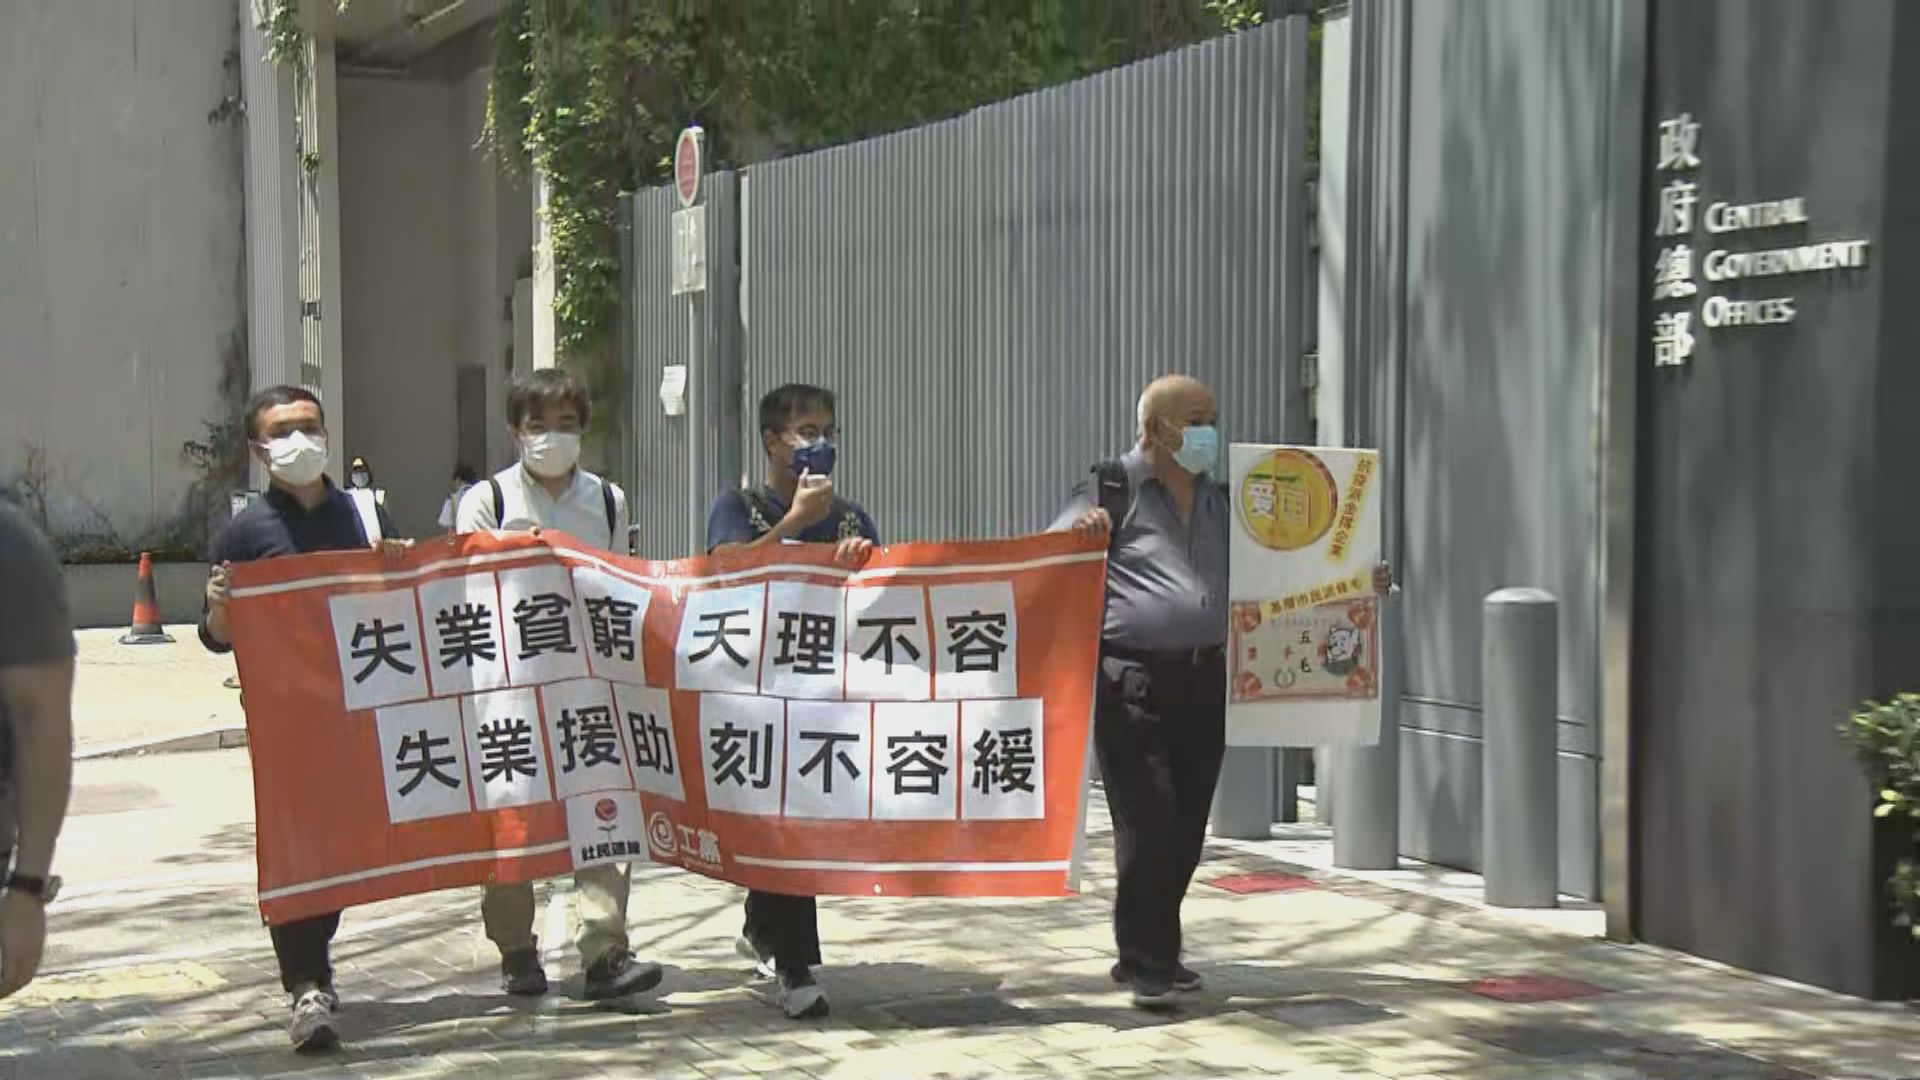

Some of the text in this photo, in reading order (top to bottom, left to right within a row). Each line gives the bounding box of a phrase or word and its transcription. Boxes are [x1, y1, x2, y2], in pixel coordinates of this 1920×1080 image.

[1652, 112, 1701, 367] 政府總部
[1704, 197, 1808, 233] CENTRAL
[1703, 240, 1869, 281] GOVERNMENT
[1703, 296, 1796, 327] OFFICES
[351, 592, 1008, 684] 失業貧窮 天理不容
[395, 705, 1036, 797] 失業援助 刻不容緩
